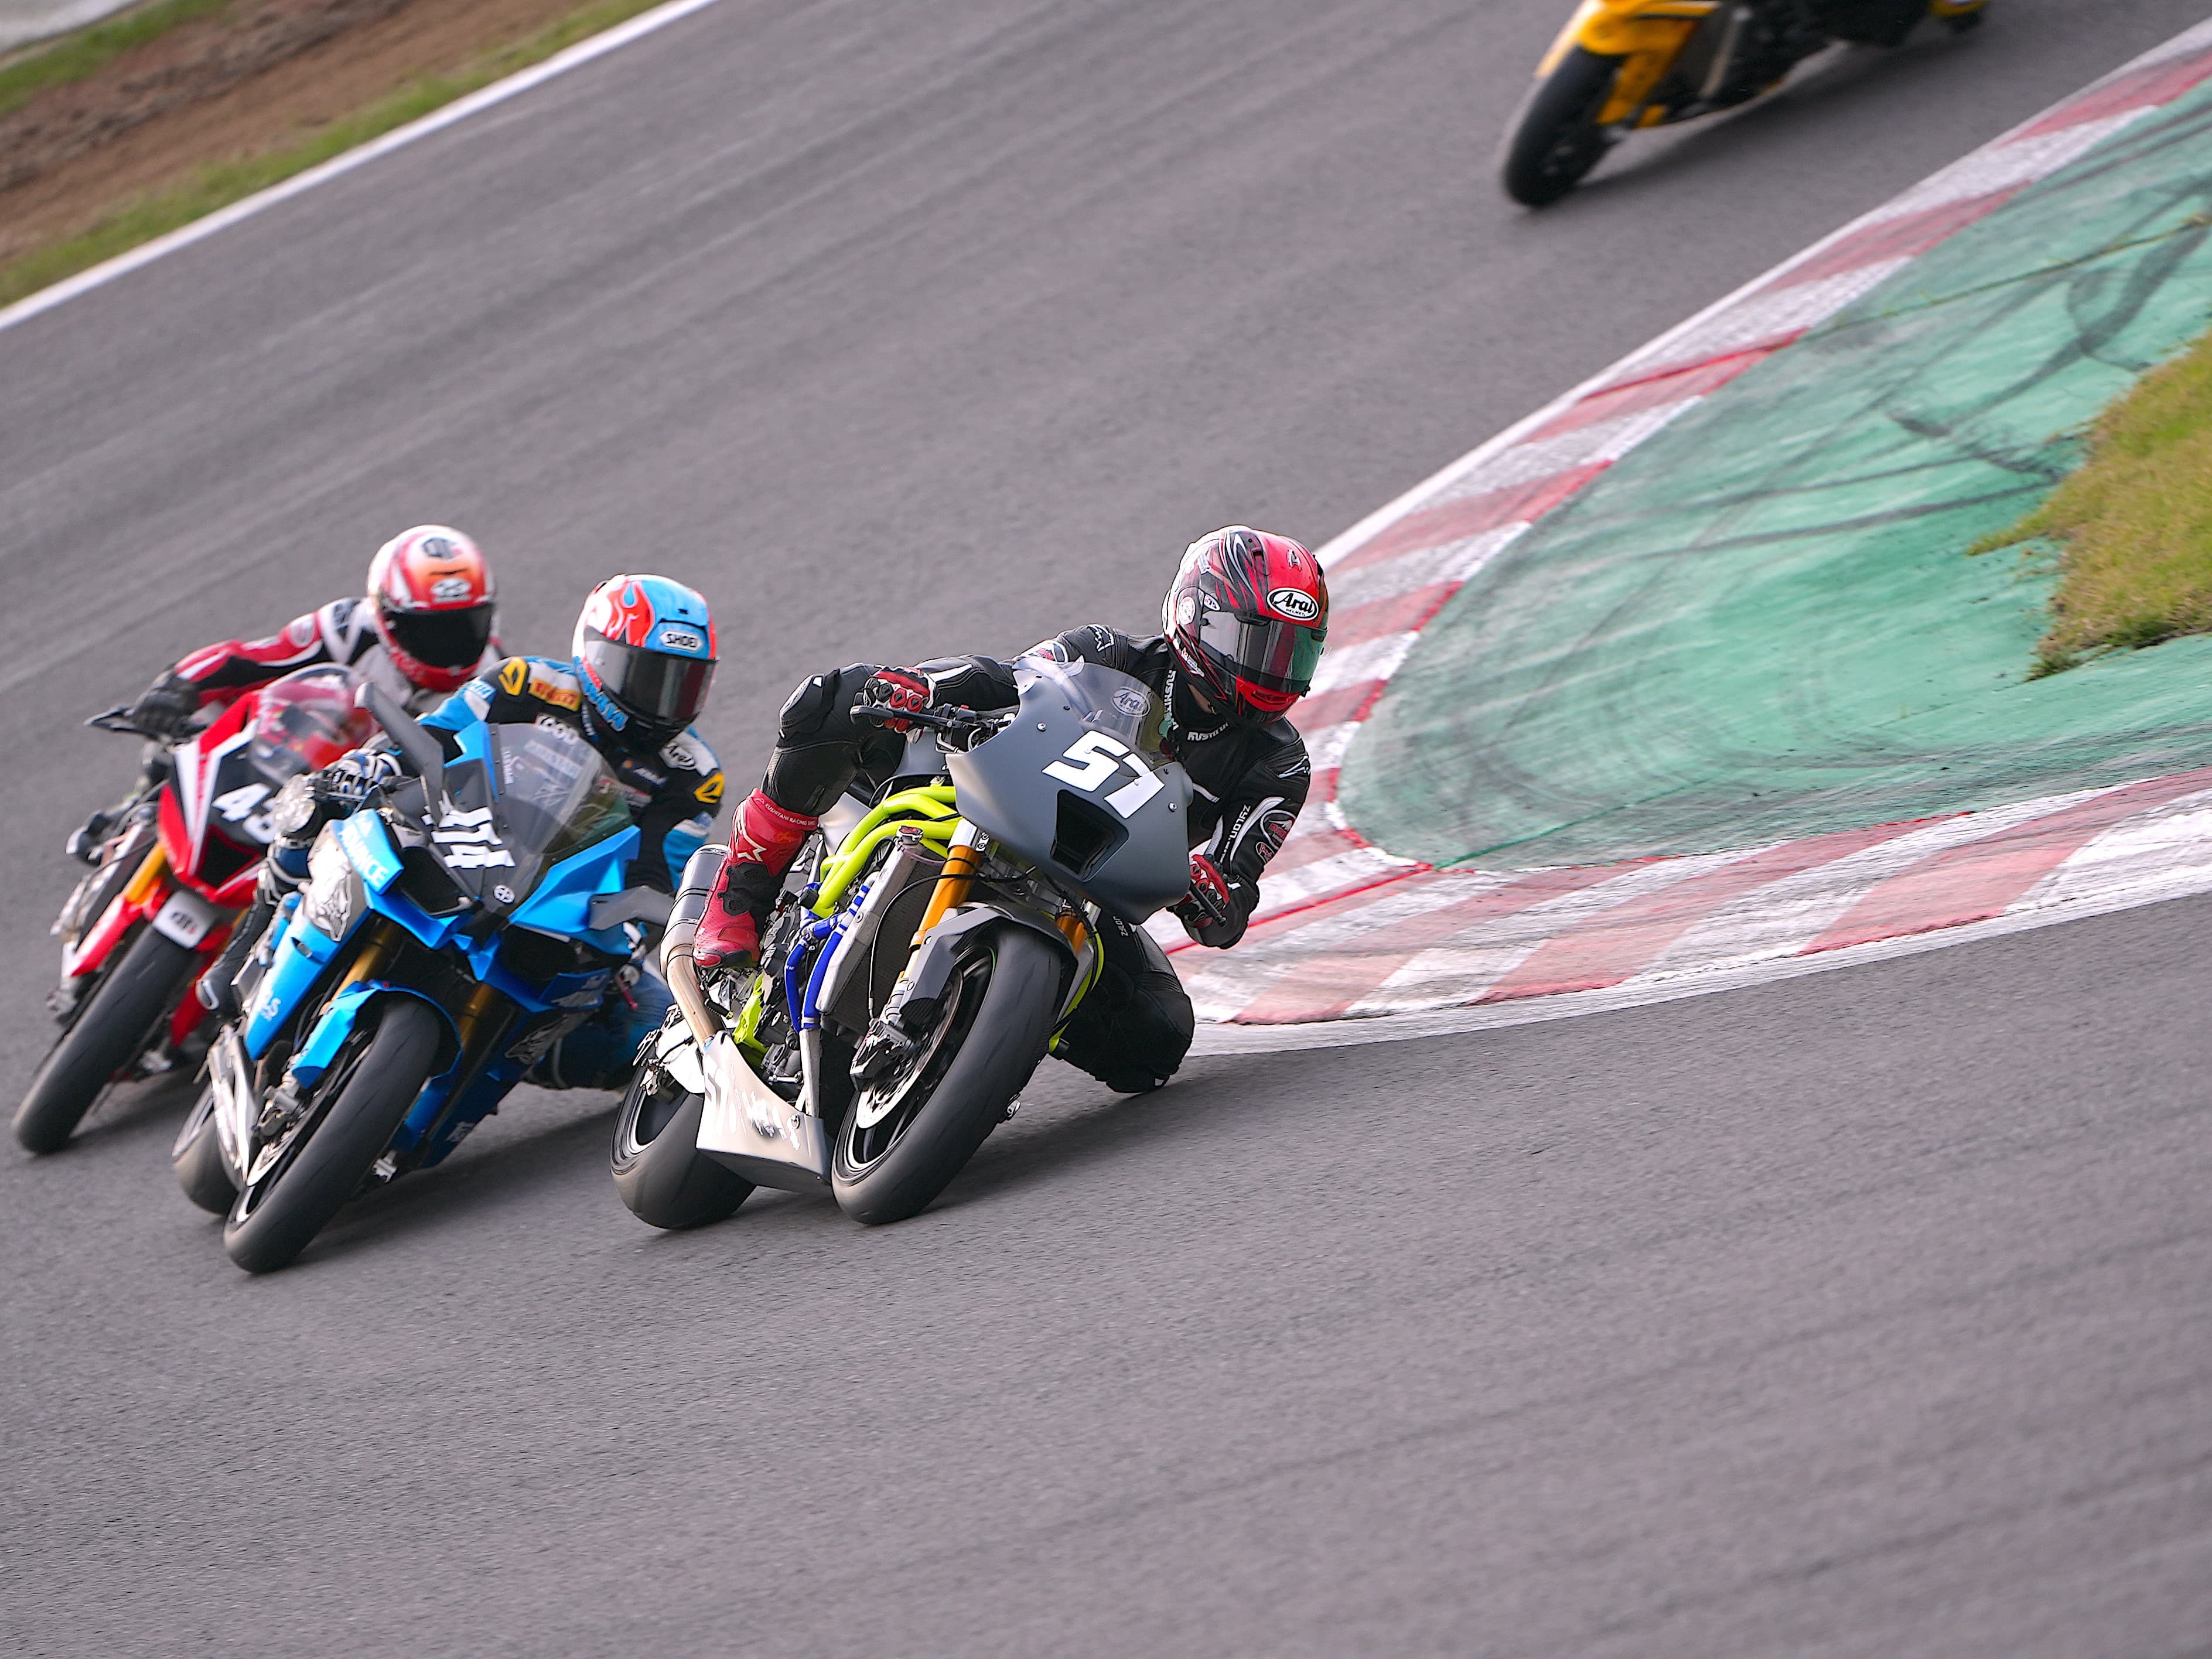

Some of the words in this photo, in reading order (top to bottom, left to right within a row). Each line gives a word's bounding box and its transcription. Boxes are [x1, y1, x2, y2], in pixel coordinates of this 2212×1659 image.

[1274, 593, 1313, 613] Arai
[667, 634, 698, 648] SHOEI
[1114, 692, 1145, 711] Arai
[1041, 730, 1166, 819] 57
[764, 803, 790, 821] KUSHITANI
